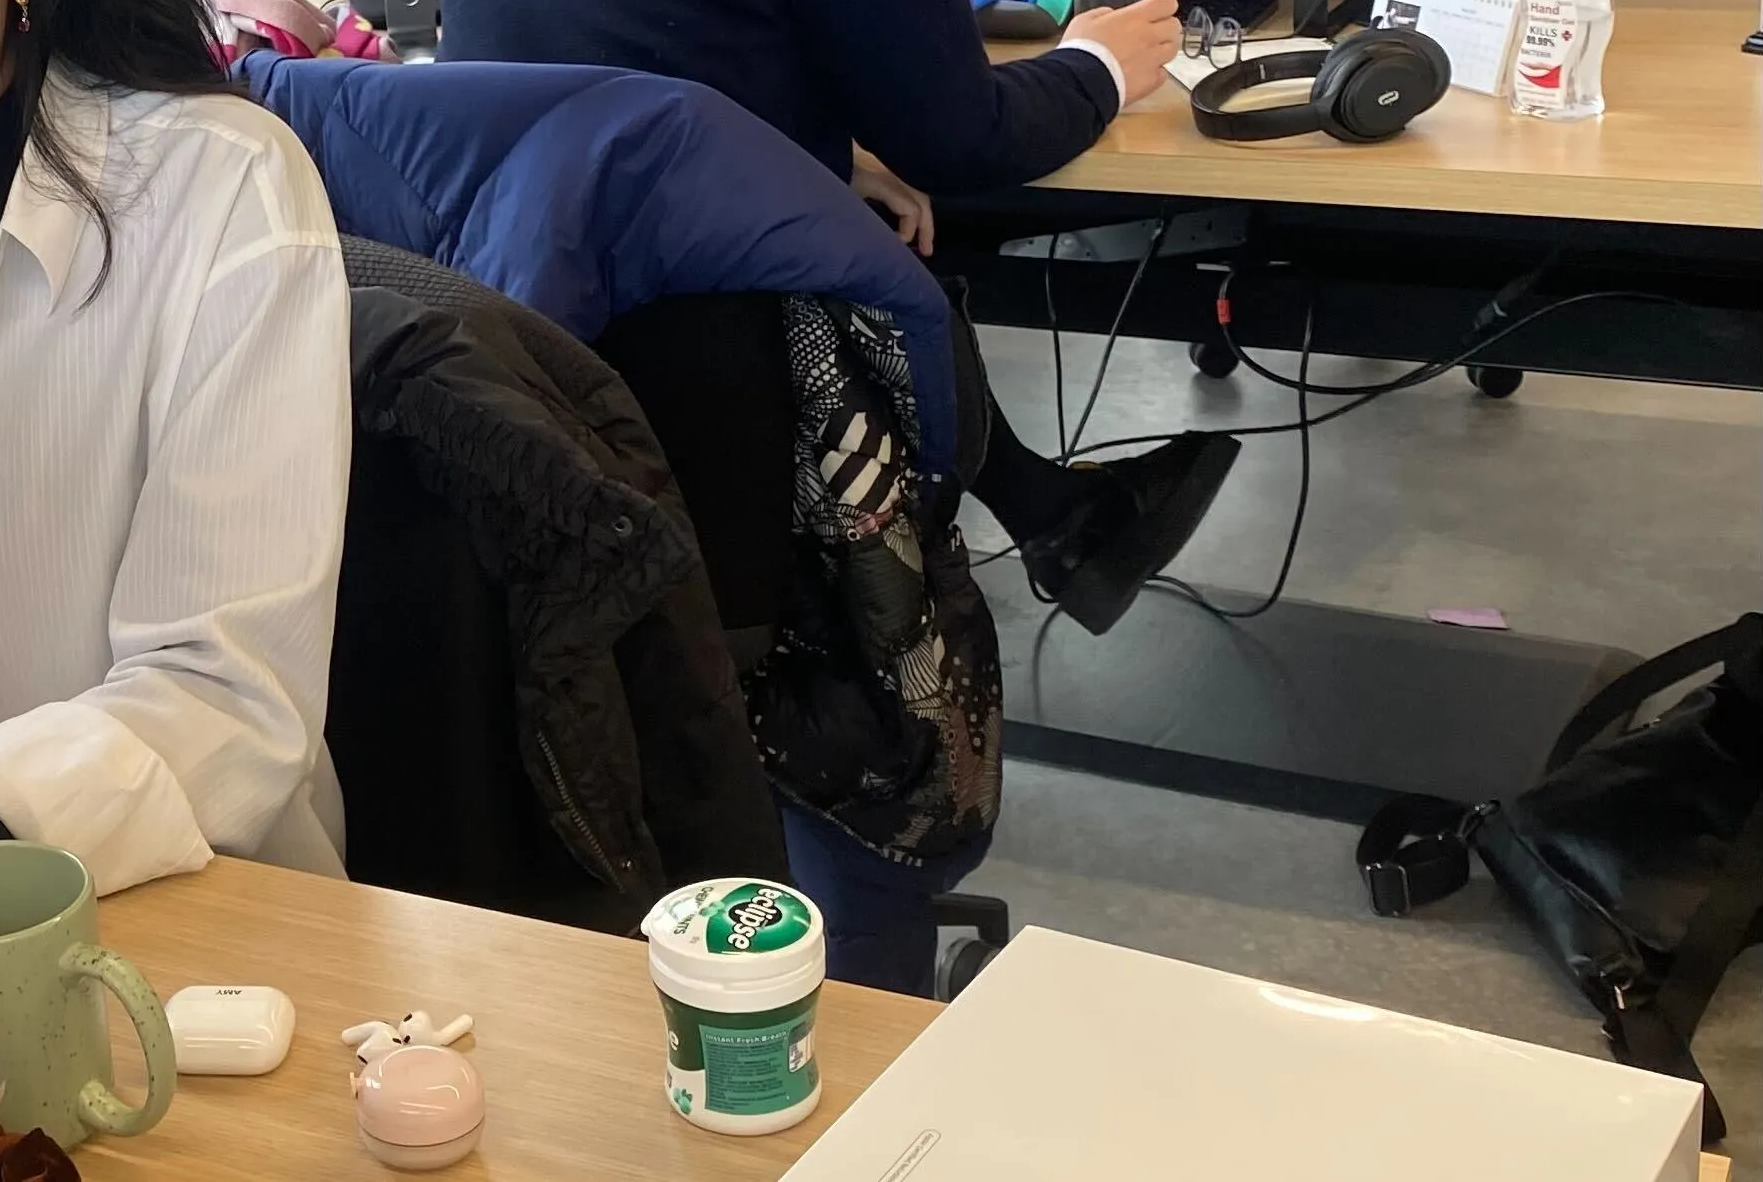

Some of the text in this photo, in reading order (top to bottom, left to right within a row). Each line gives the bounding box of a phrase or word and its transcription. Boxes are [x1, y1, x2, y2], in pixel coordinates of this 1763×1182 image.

[1530, 2, 1560, 15] Hand
[1529, 26, 1558, 38] KILLS
[727, 887, 783, 950] eclipse
